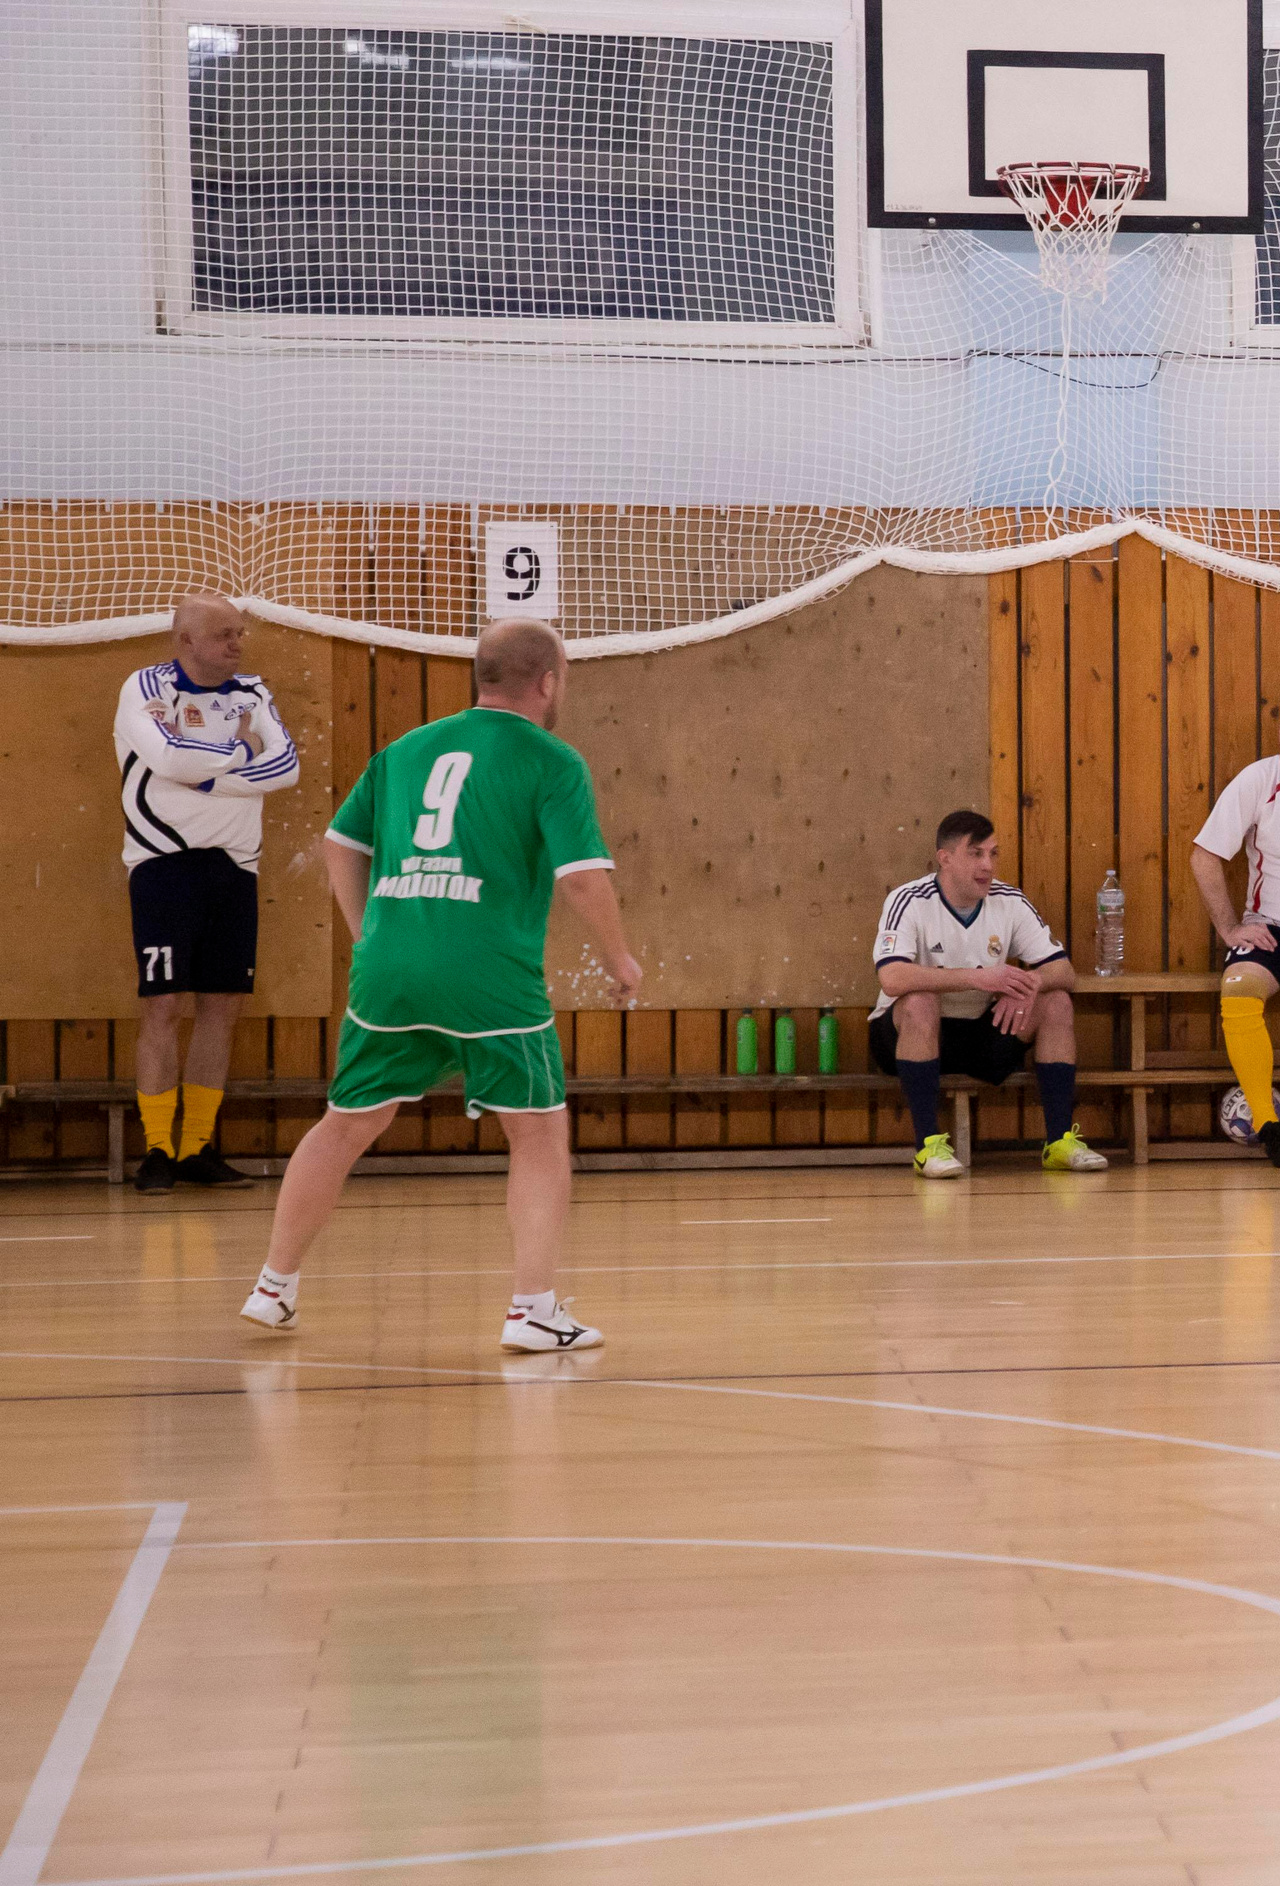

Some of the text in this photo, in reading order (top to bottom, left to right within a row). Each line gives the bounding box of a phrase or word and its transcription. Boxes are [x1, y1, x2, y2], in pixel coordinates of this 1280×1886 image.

[503, 547, 541, 601] 9
[412, 751, 473, 850] 9
[143, 946, 173, 981] 71
[1223, 1089, 1244, 1116] ELECT
